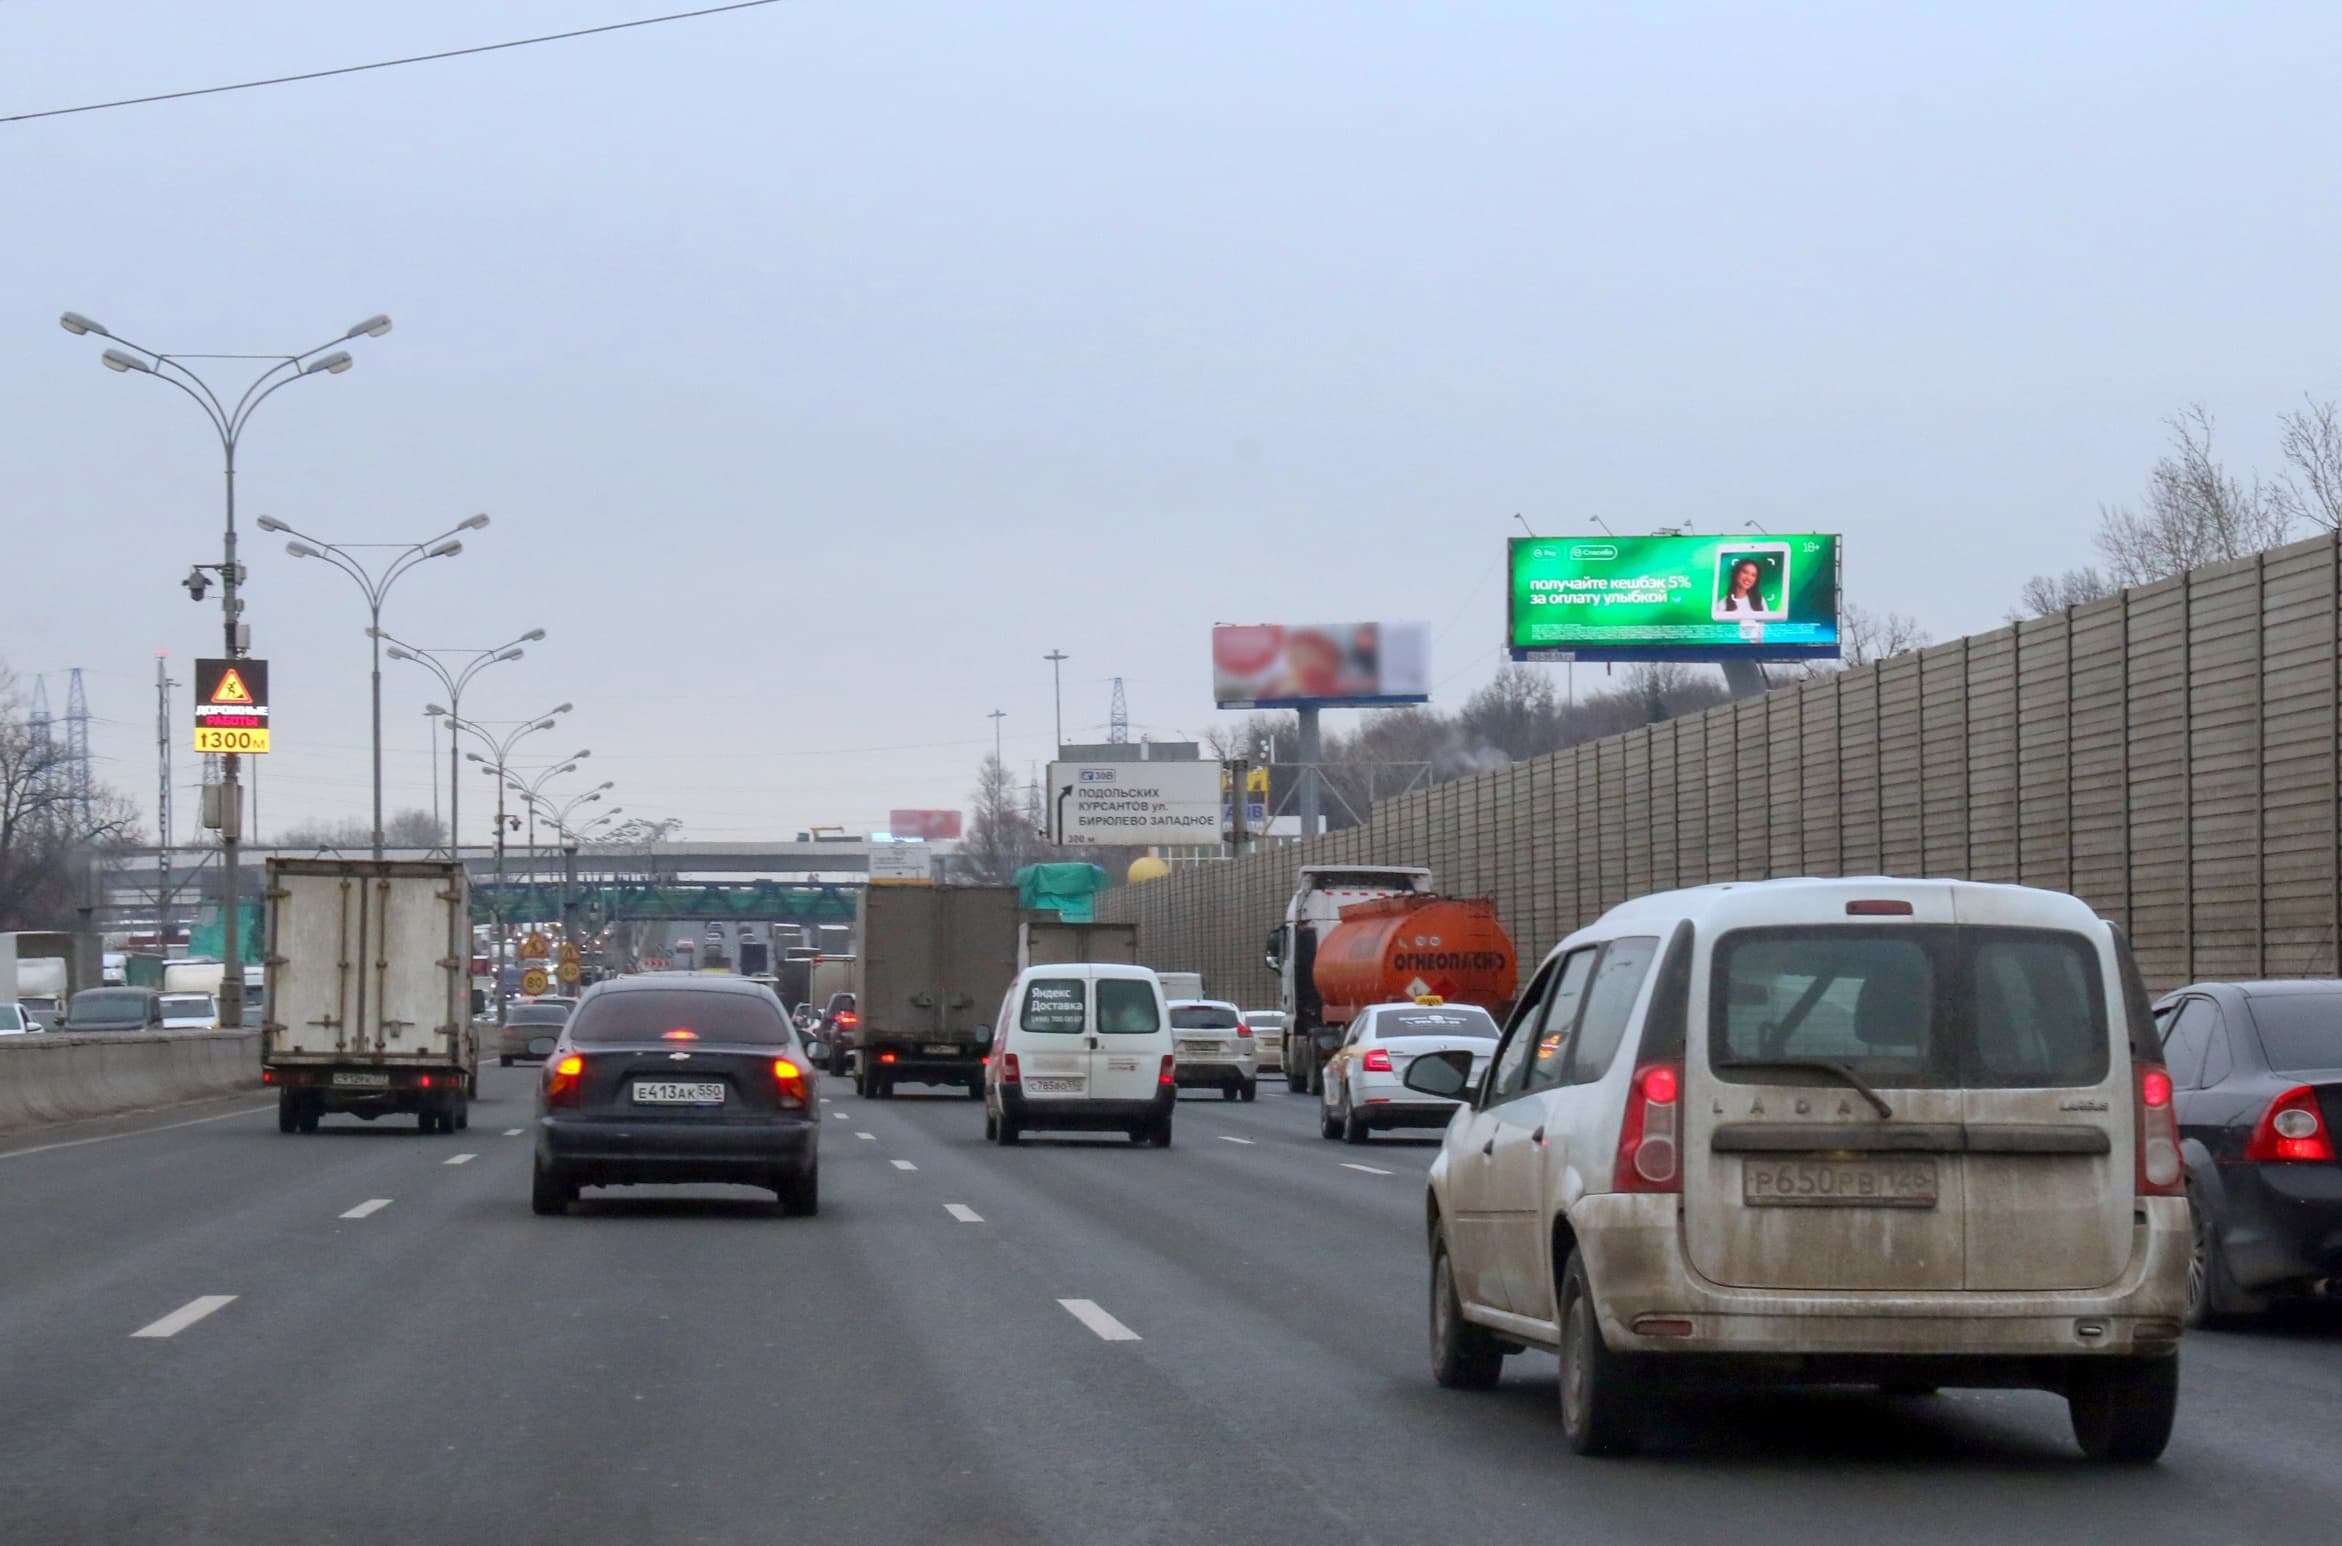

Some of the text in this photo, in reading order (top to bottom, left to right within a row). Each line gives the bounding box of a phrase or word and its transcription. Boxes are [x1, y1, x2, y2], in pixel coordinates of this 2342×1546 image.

[1529, 575, 1692, 592] получайте кешбэк 5%
[1529, 590, 1668, 606] за оплату улыбкой
[196, 705, 269, 717] ДОРОЖНЫЕ
[205, 715, 259, 726] РАБОТЫ
[210, 732, 251, 748] 300
[1078, 788, 1160, 798] ПОДОЛЬСКИХ
[1078, 801, 1168, 813] КУРСАНТОВ ул.
[1079, 815, 1215, 826] БИРЮЛЕВО ЗАПАДНОЕ
[1032, 987, 1071, 999] Яндекс
[1032, 1000, 1083, 1011] Доставка
[1712, 1098, 1852, 1115] LADA
